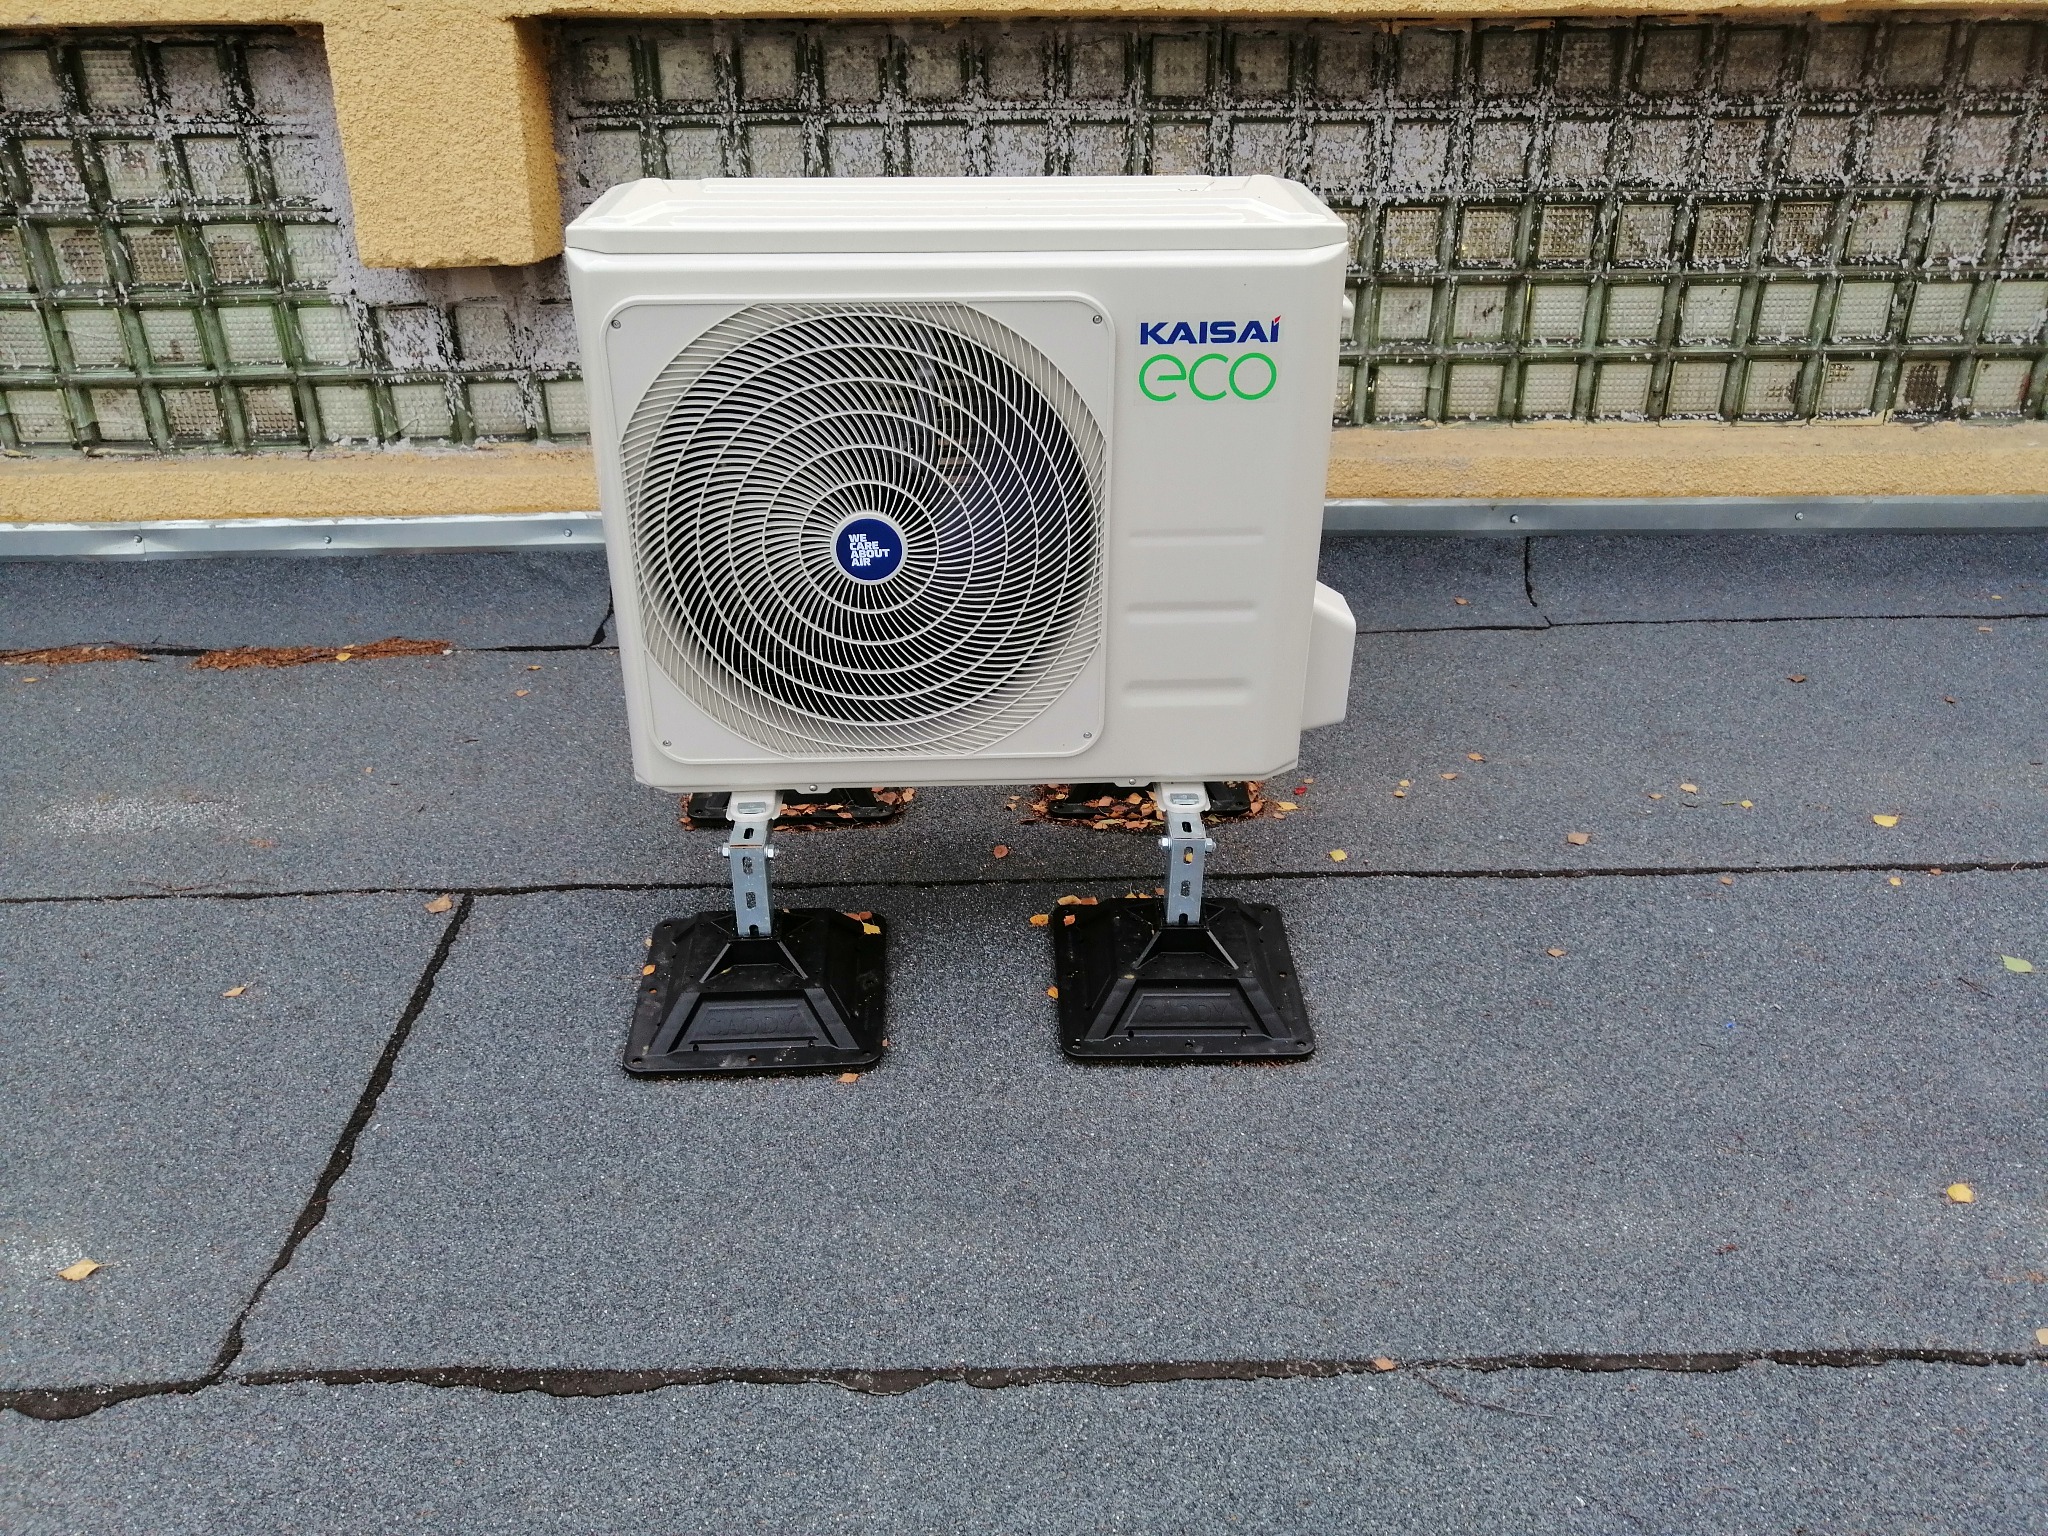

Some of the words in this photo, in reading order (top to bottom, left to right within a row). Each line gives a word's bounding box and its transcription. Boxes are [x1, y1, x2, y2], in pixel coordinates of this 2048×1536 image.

[1138, 352, 1277, 402] eco
[848, 534, 867, 542] WE
[849, 541, 879, 550] CARE
[851, 549, 890, 558] ABOUT
[851, 558, 871, 566] AIR
[705, 1012, 801, 1036] CADDY
